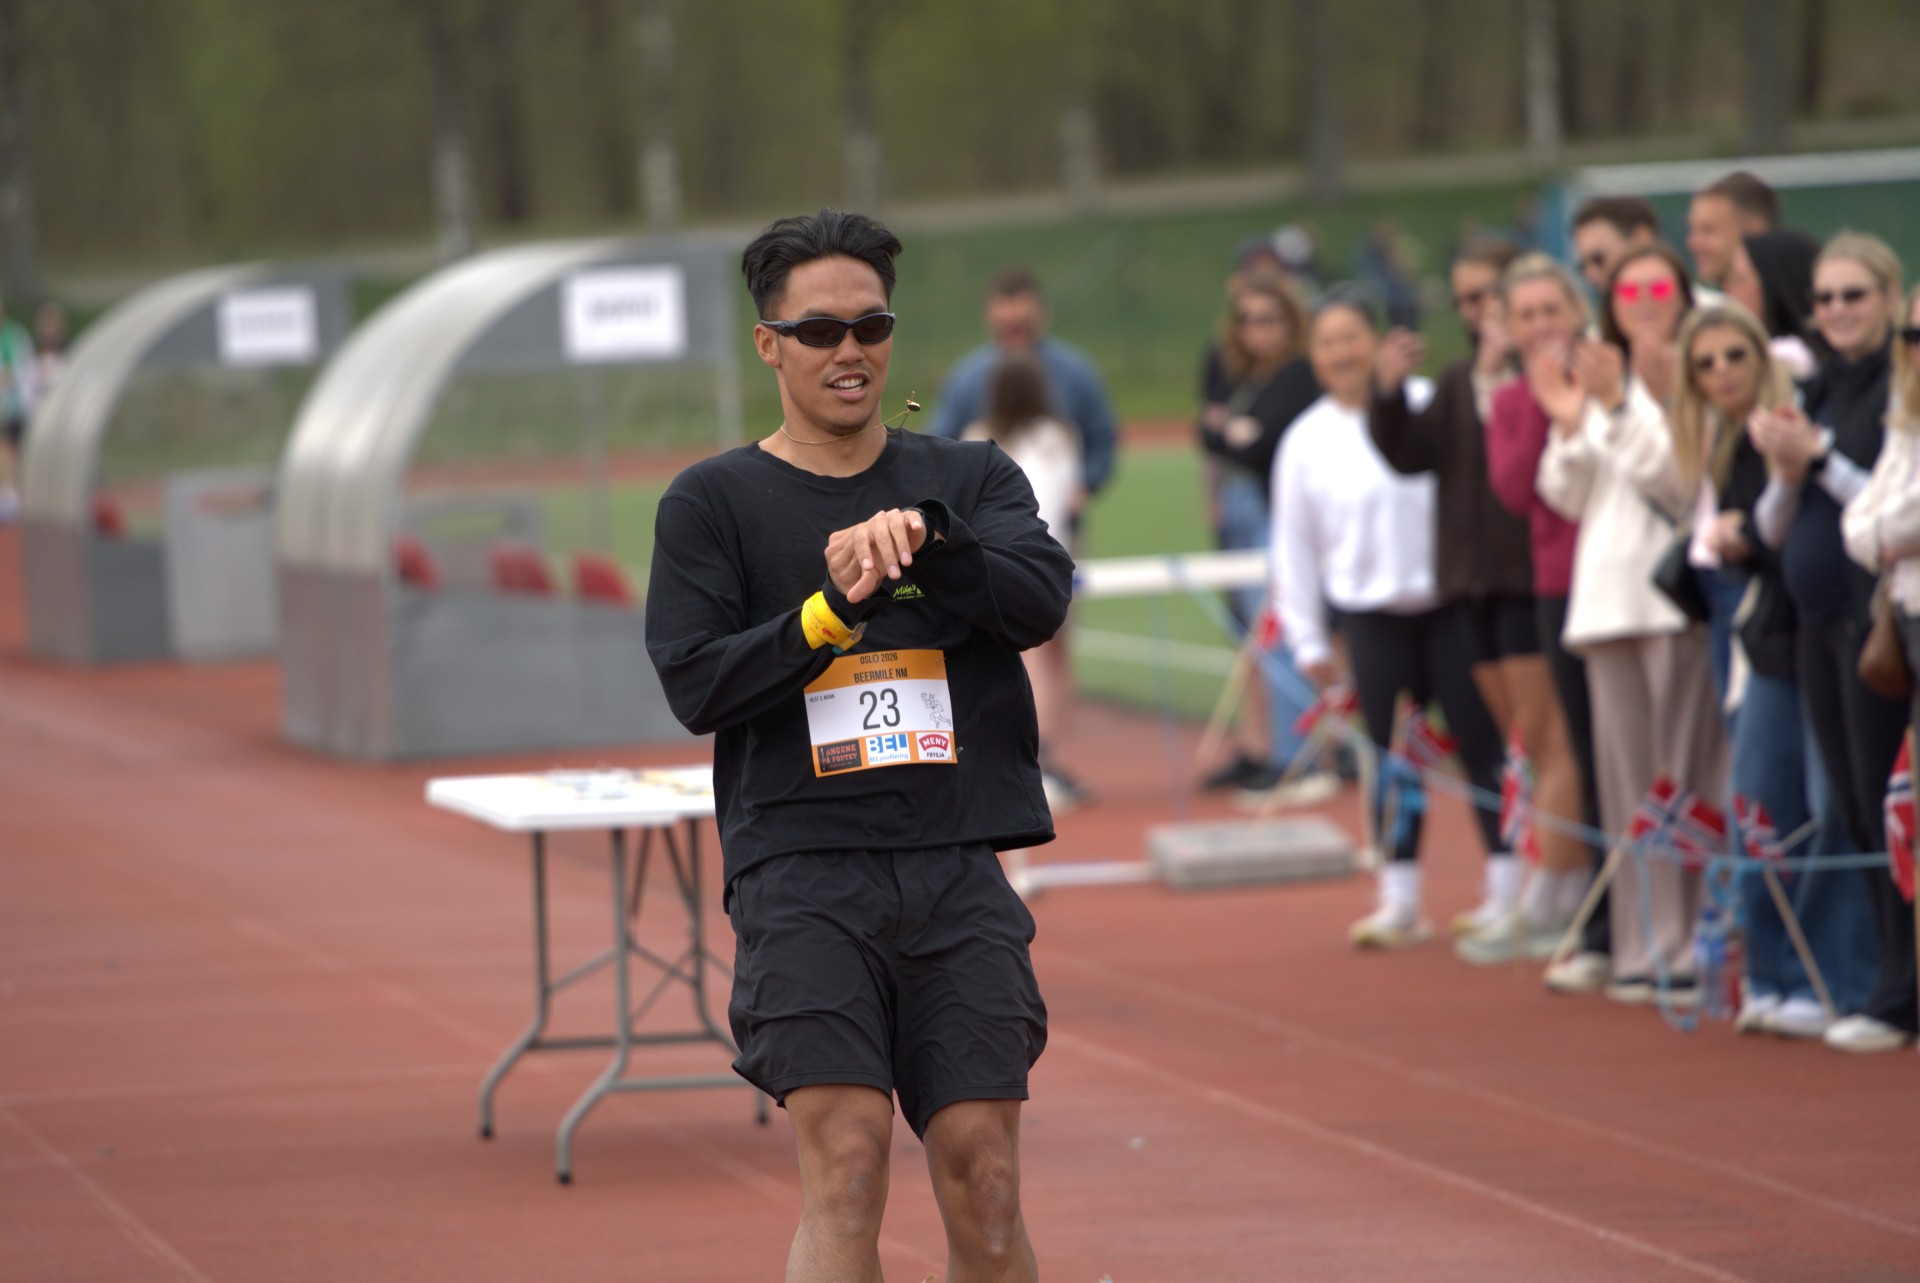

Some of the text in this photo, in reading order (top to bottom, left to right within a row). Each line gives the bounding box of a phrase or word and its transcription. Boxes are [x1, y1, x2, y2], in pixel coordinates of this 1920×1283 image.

[860, 652, 898, 665] OSLO 2026
[853, 667, 908, 683] BEERMILE NM
[859, 688, 901, 731] 23
[868, 733, 908, 754] BEL
[922, 736, 947, 748] MENY
[868, 753, 909, 763] BEL profilering
